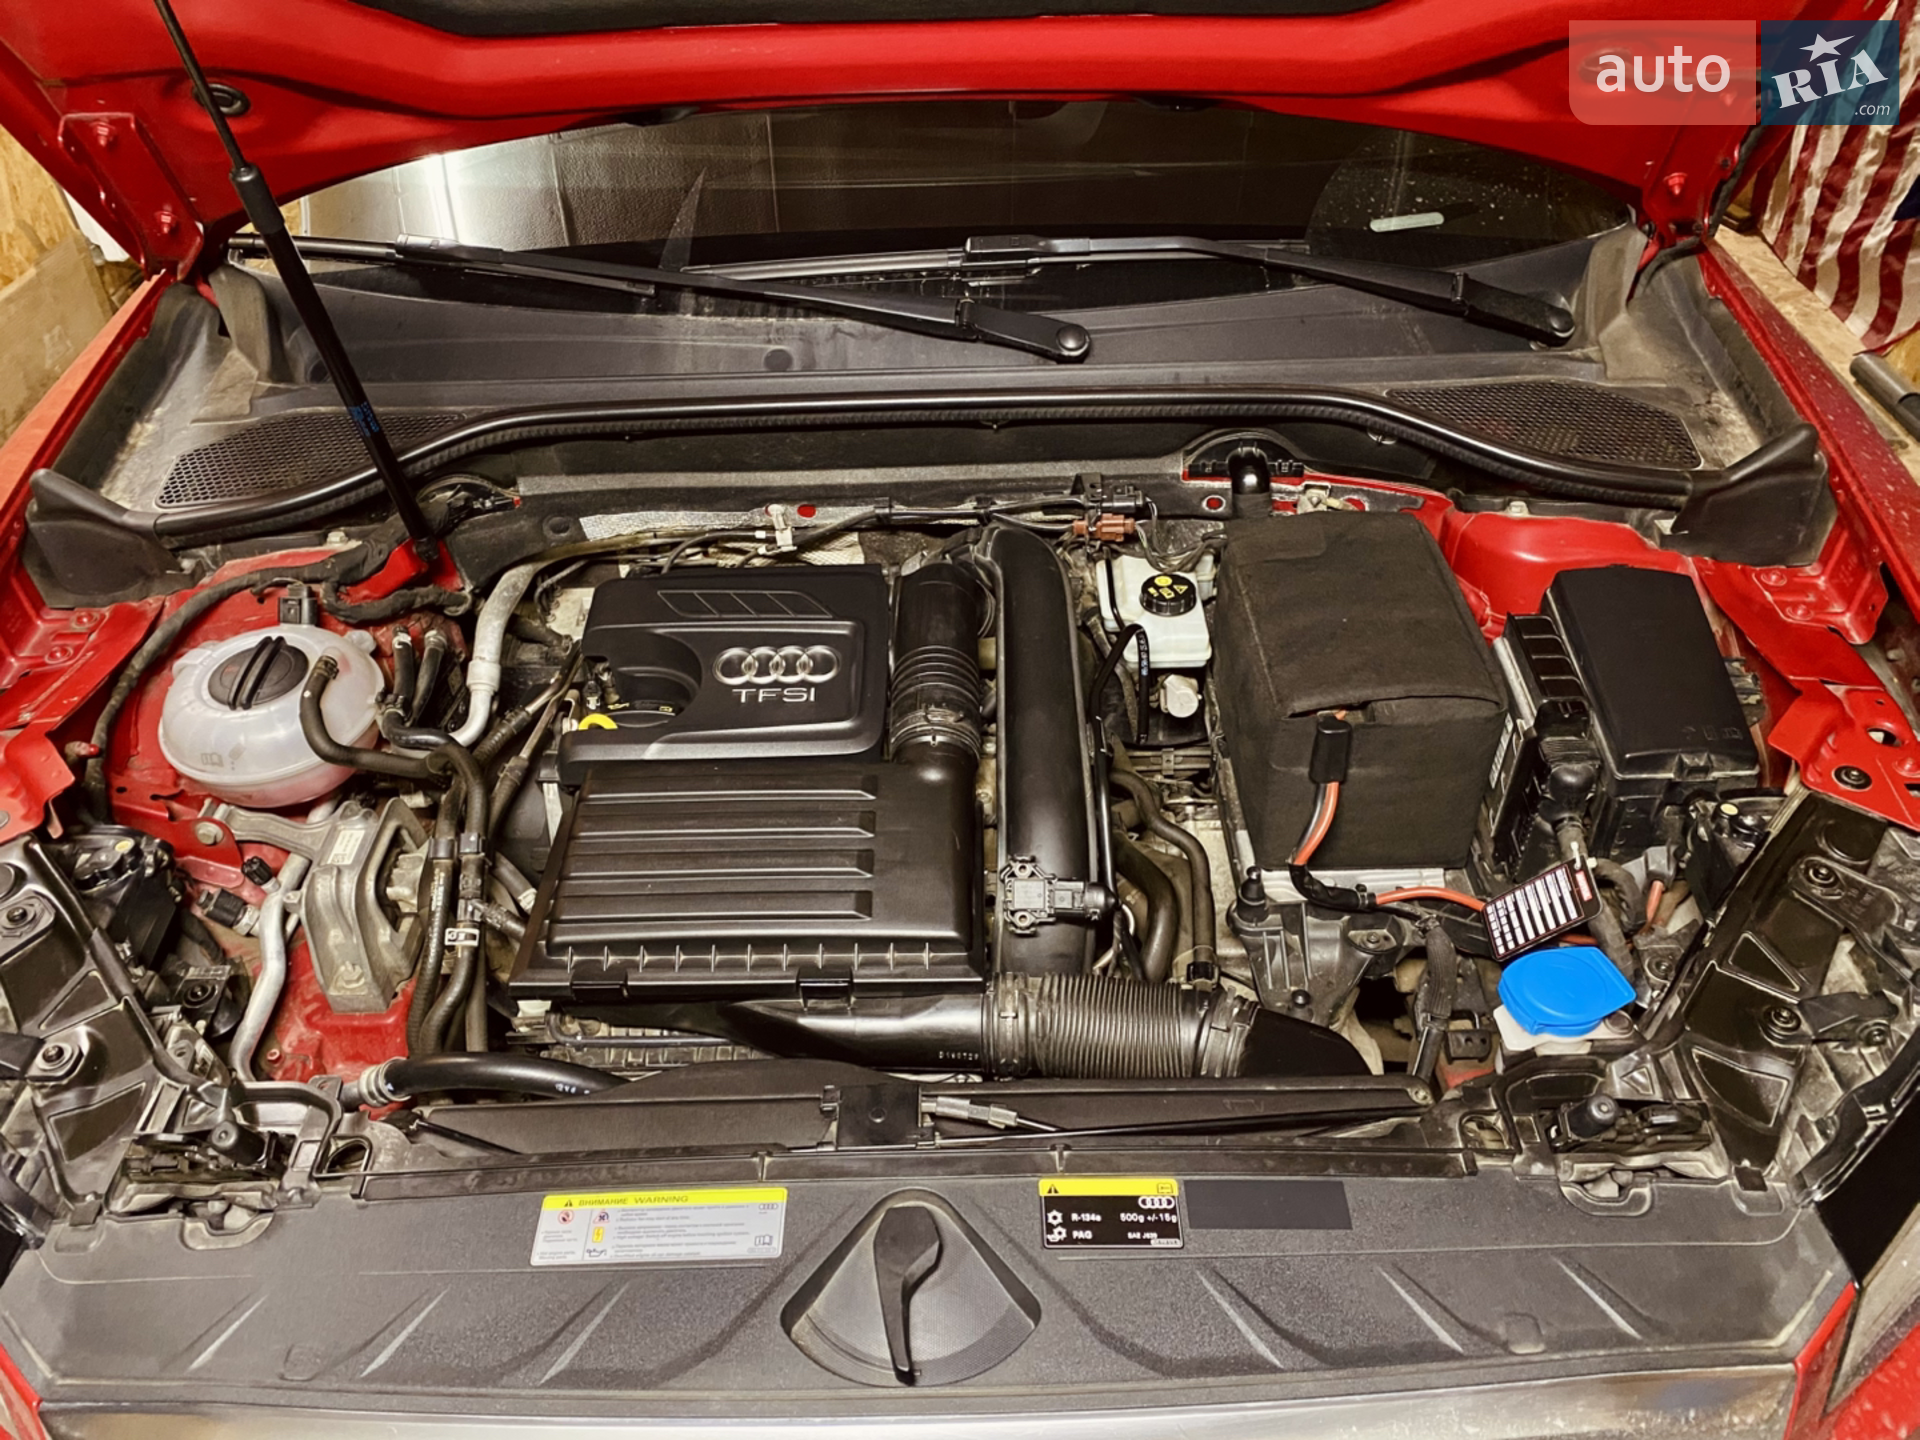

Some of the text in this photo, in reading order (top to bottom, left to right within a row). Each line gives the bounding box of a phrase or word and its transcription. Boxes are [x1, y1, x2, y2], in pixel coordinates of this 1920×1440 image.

[732, 687, 816, 703] TFSI
[634, 1195, 689, 1204] WARNING
[1120, 1213, 1145, 1223] 500g
[1072, 1230, 1093, 1239] PAG
